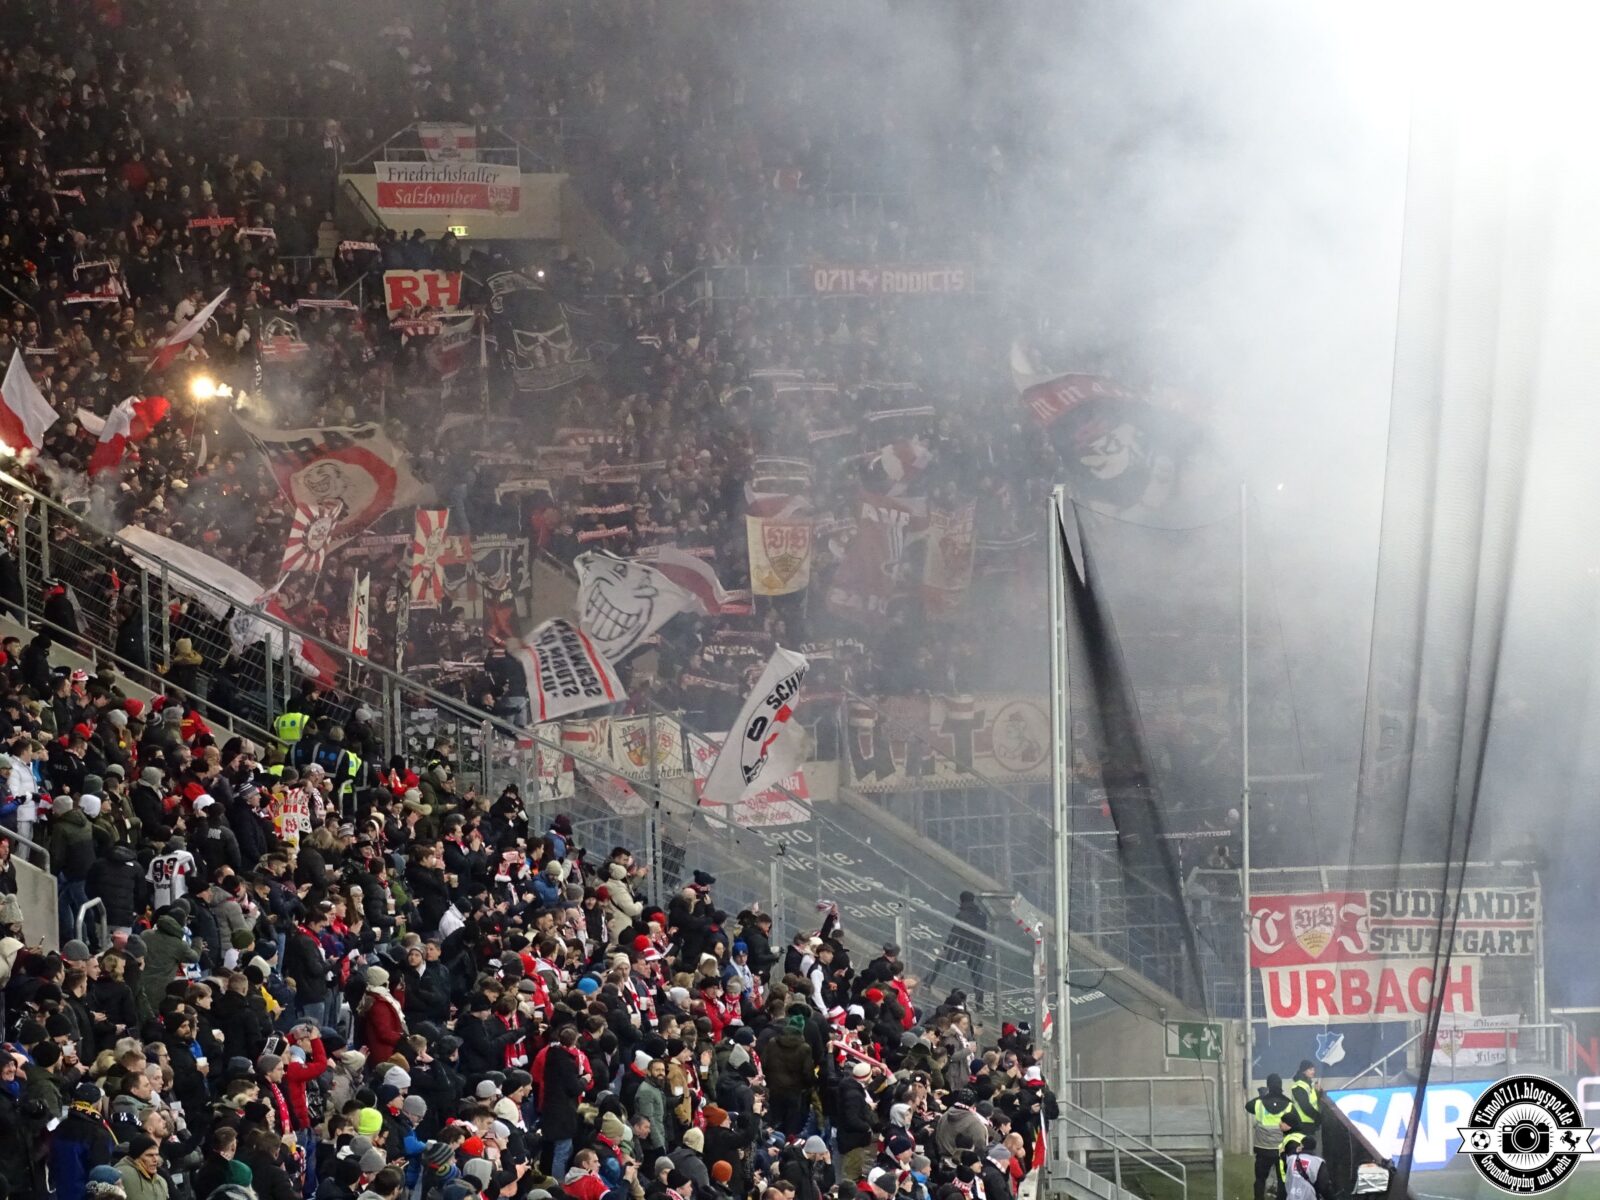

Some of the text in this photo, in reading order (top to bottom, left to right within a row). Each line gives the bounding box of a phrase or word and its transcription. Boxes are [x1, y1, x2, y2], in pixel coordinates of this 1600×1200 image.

[387, 164, 501, 184] Friedrichshaller
[395, 186, 477, 205] Salzbomber
[390, 271, 461, 311] RH
[813, 267, 855, 292] 0711
[1369, 927, 1535, 954] STUTTGART
[1268, 965, 1475, 1019] URBACH
[1335, 1089, 1474, 1164] SAP
